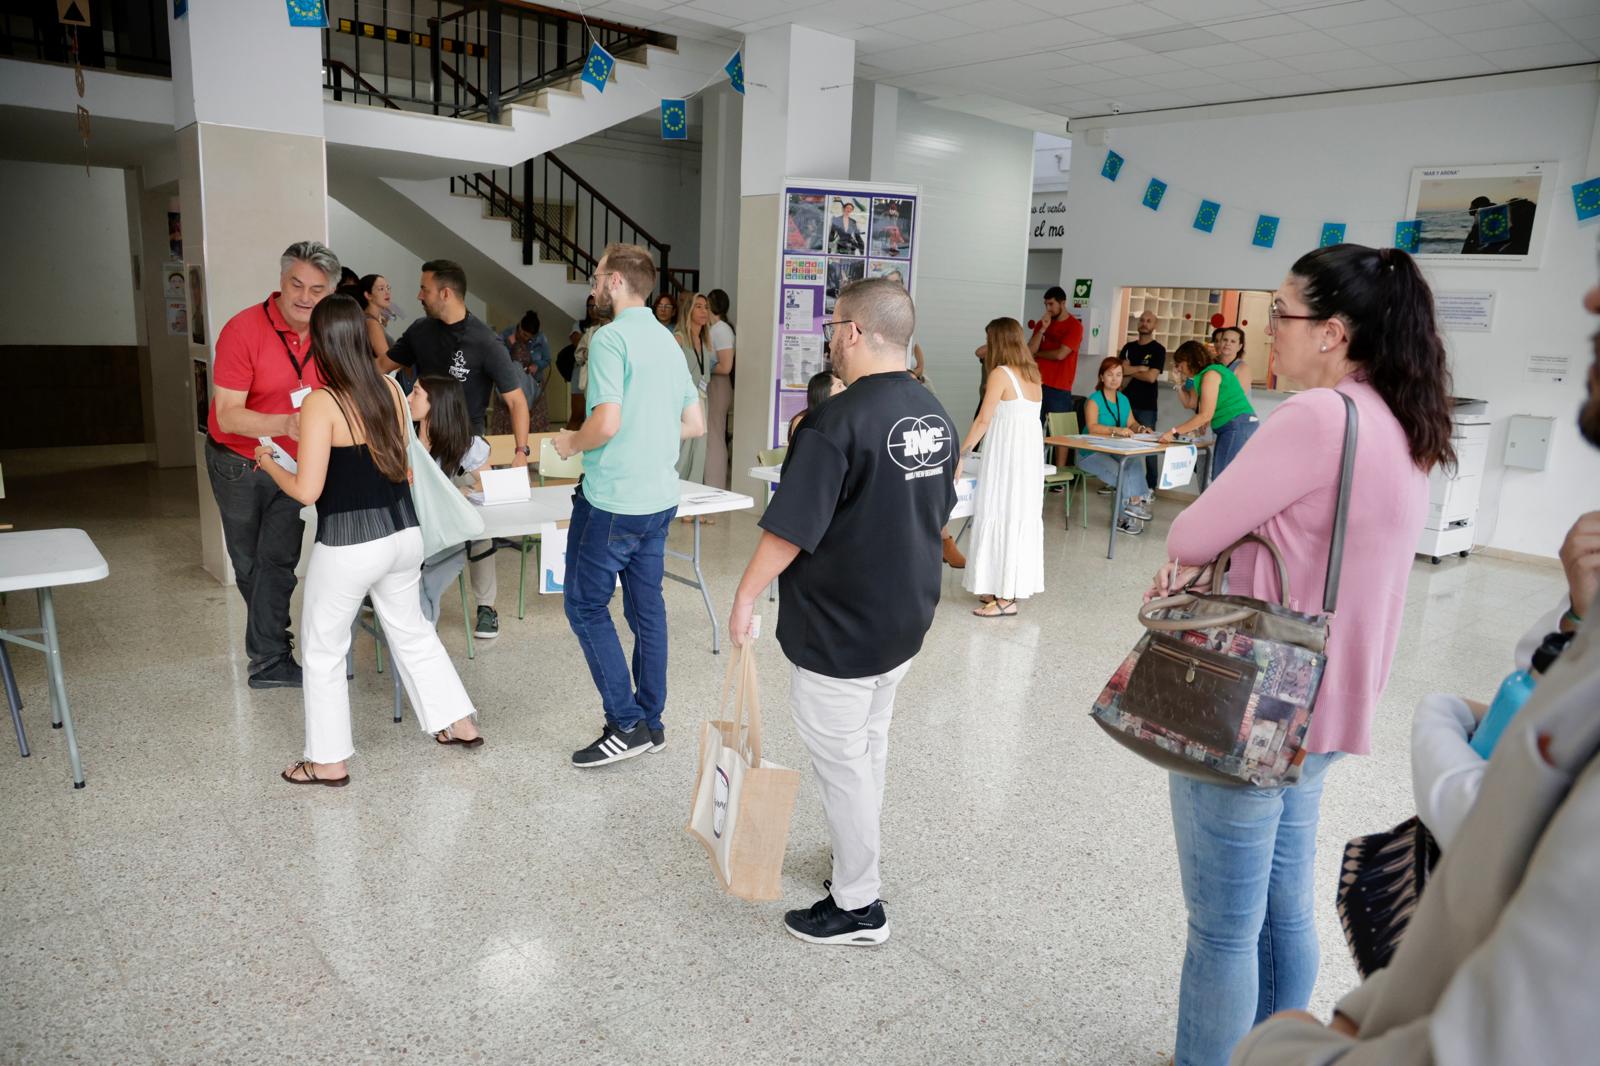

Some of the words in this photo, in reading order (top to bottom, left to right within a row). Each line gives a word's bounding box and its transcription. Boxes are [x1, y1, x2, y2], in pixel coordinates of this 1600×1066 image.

[1039, 202, 1046, 214] el
[1034, 219, 1046, 237] el
[902, 427, 944, 457] INC
